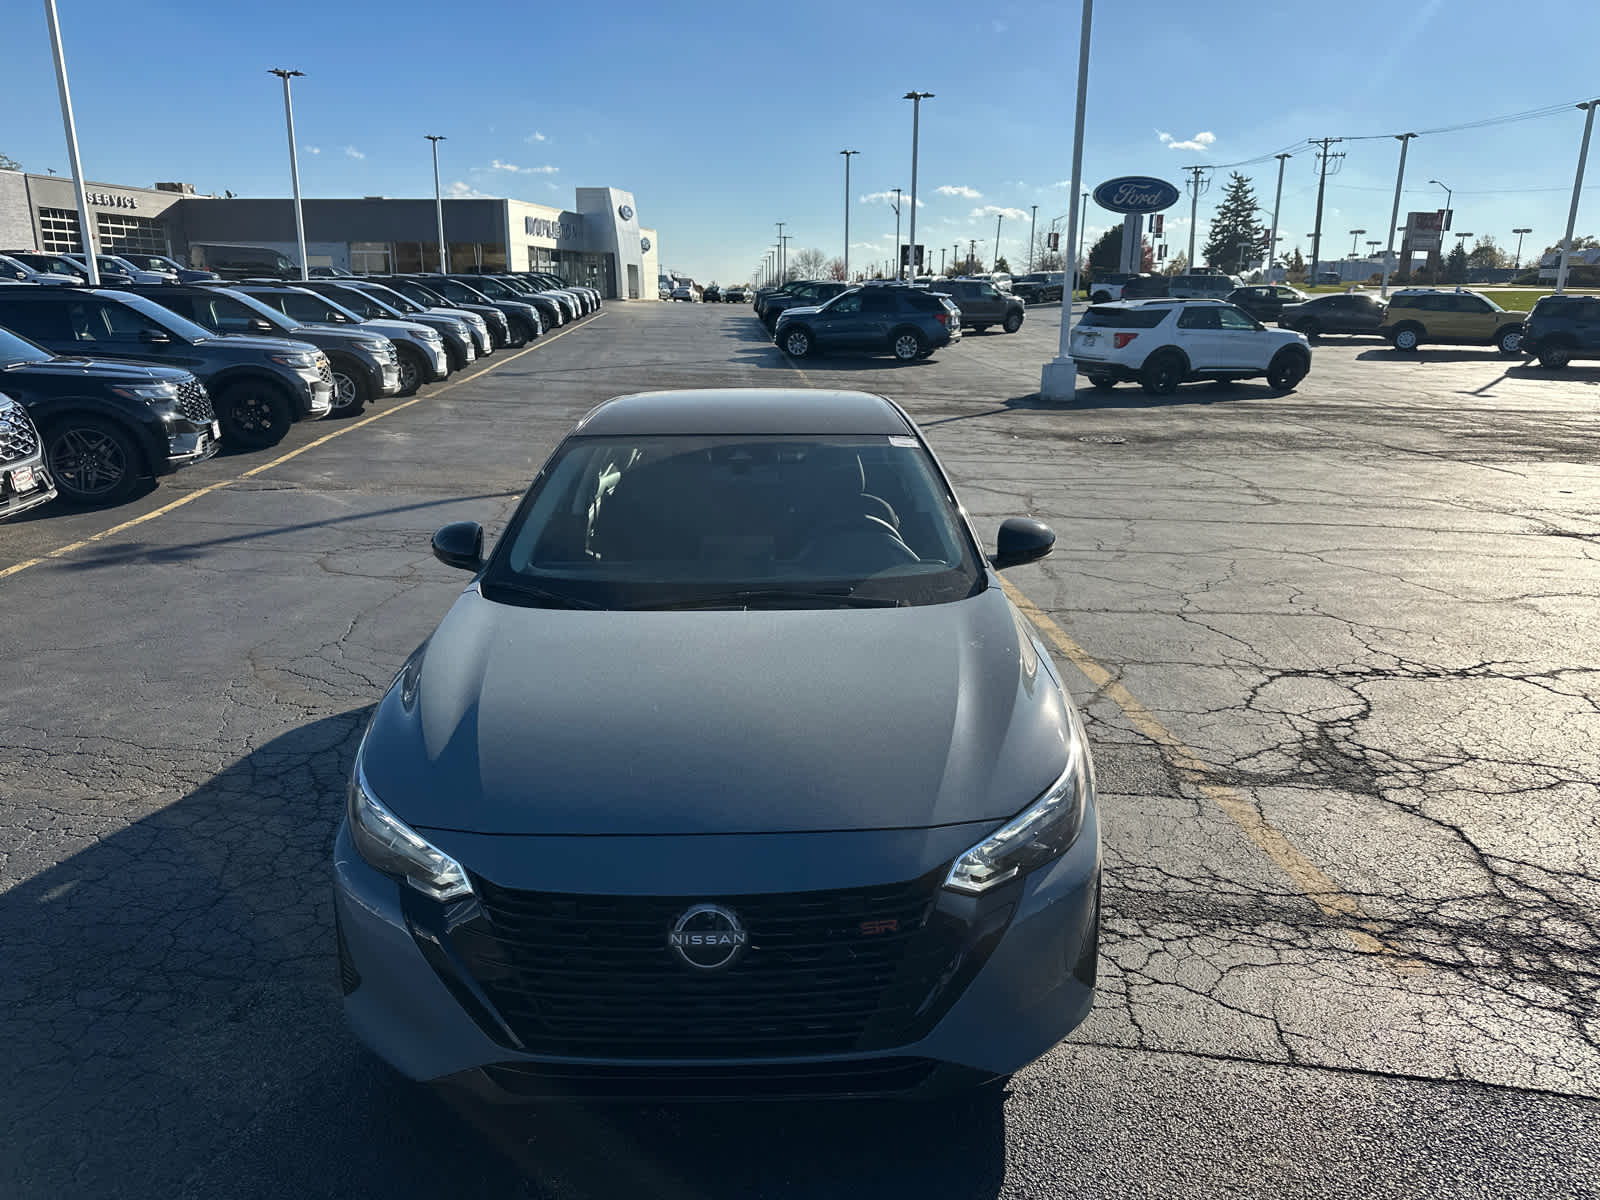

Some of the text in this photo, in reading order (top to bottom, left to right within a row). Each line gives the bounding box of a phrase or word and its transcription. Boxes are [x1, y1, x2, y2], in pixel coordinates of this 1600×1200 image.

[87, 191, 137, 209] SERVICE
[1113, 183, 1162, 205] Ford
[861, 919, 898, 935] SR
[671, 933, 745, 945] NISSAN
